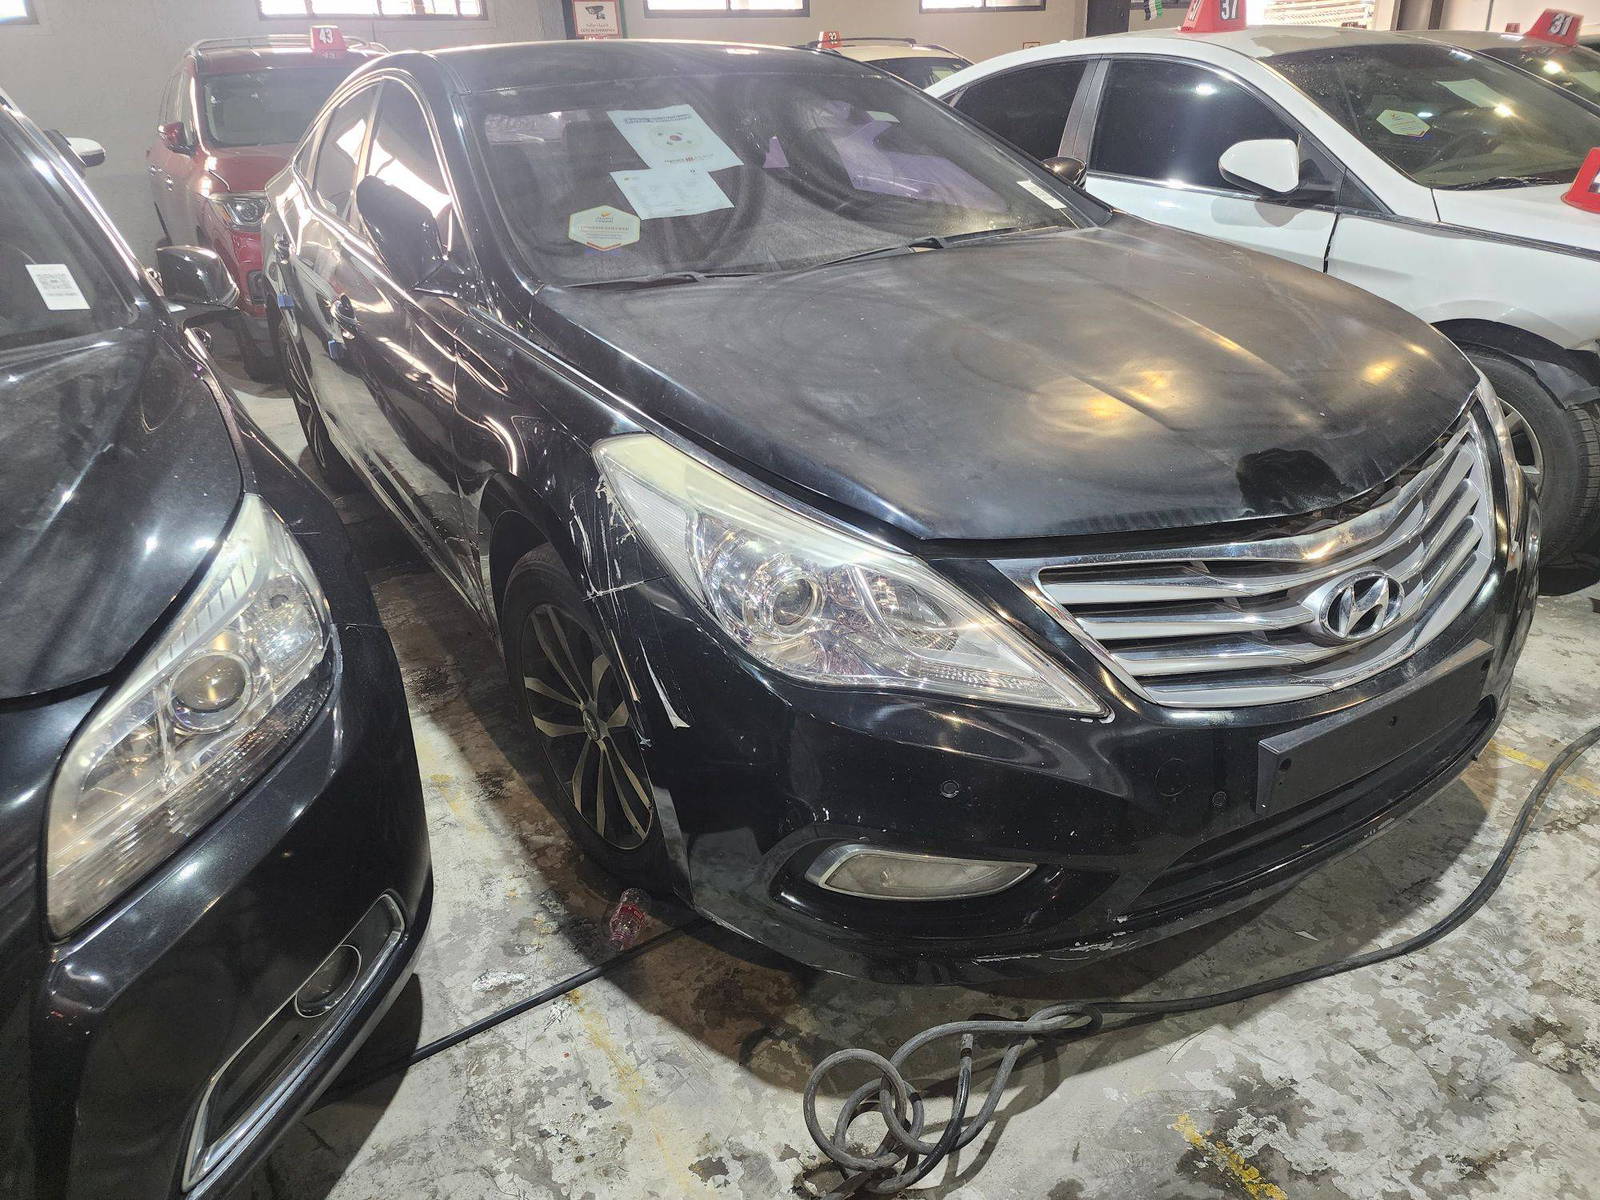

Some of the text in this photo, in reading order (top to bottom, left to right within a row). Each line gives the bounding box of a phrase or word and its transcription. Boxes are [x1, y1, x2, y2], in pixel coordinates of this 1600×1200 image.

[1221, 0, 1238, 20] 37
[1550, 12, 1574, 36] 31
[320, 28, 333, 44] 43
